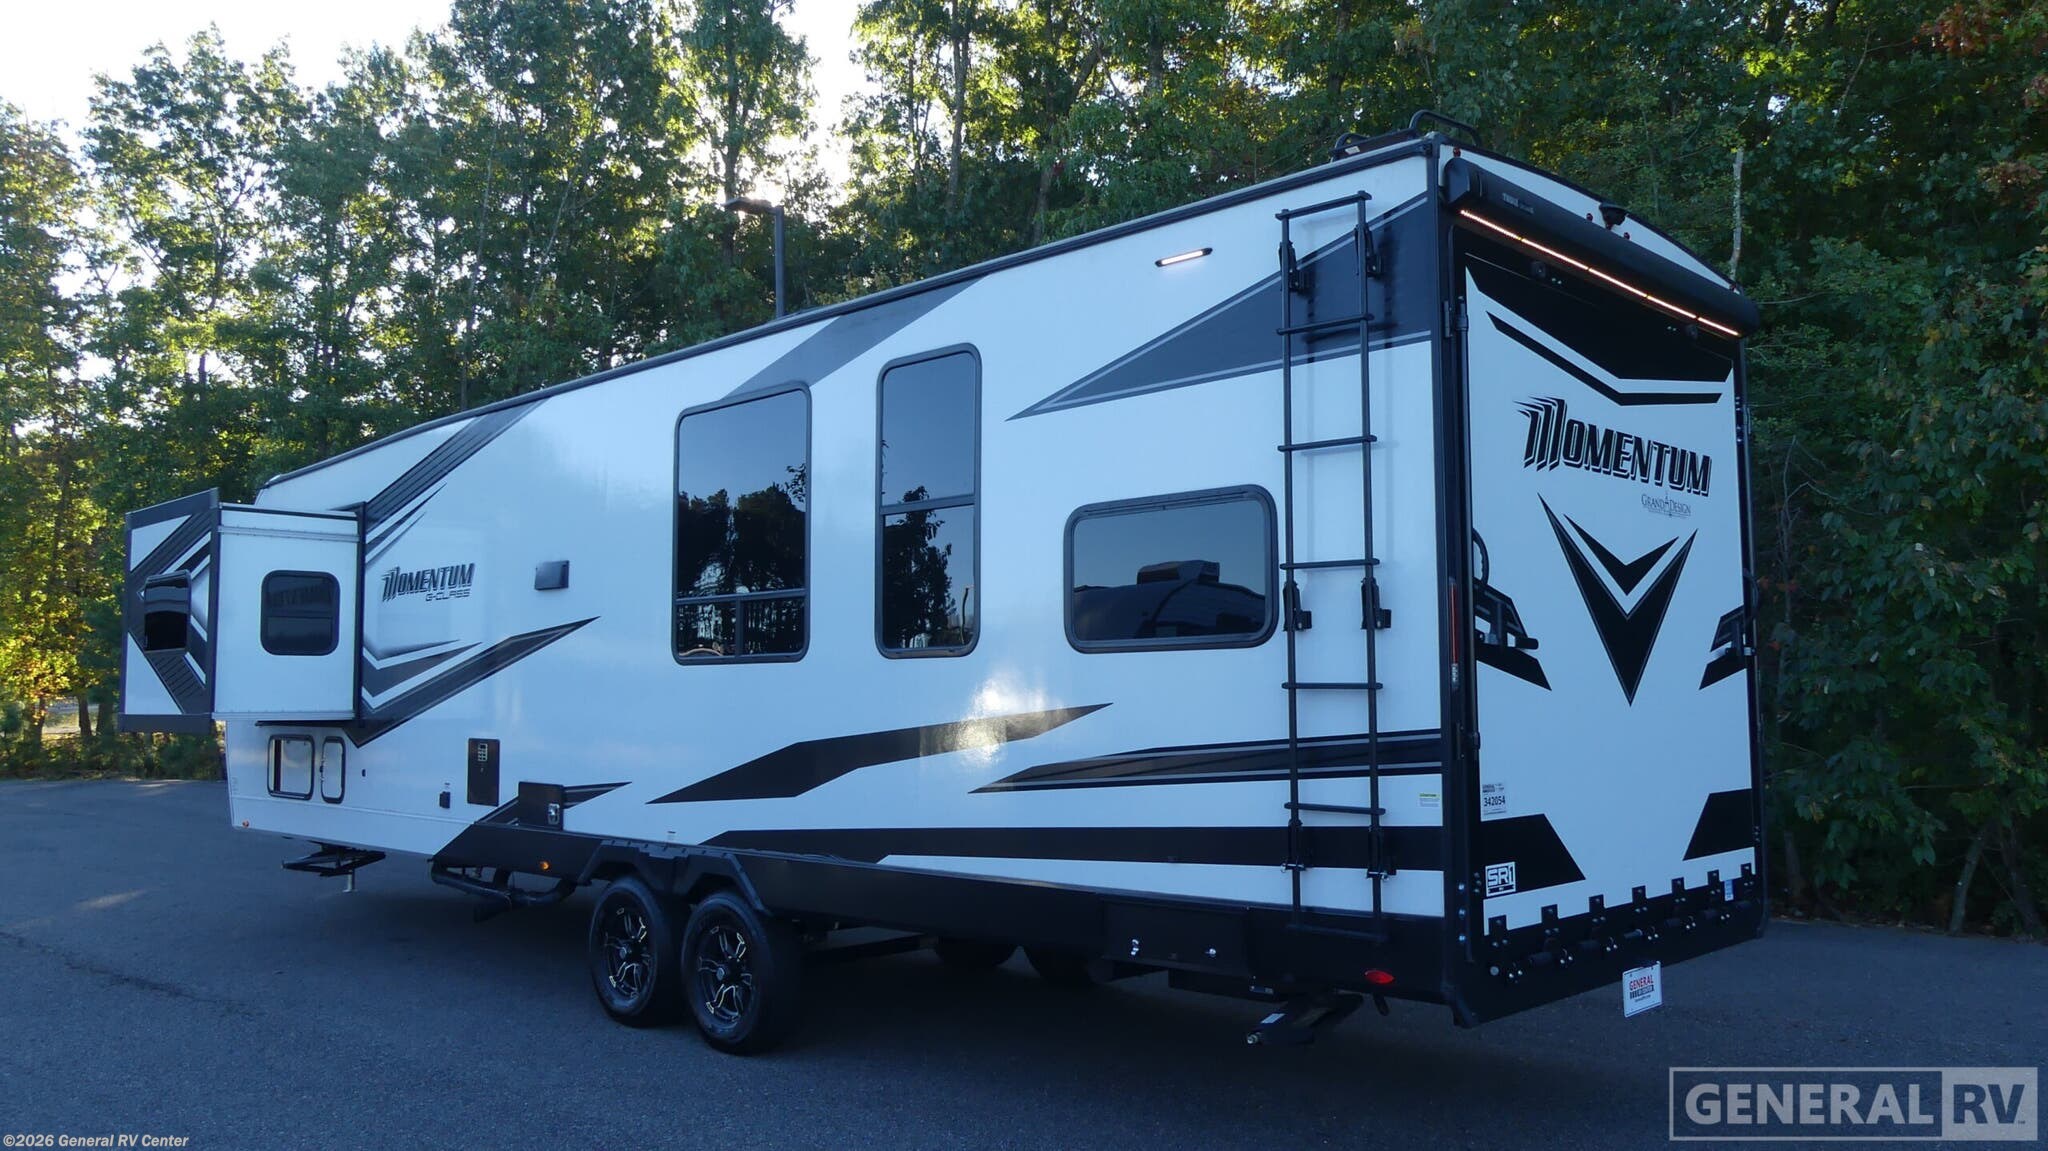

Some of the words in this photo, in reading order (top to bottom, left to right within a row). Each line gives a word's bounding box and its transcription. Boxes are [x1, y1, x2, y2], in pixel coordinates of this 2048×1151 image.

[1513, 395, 1712, 497] MOMENTUM
[381, 563, 475, 602] MOMENTUM
[425, 588, 471, 602] G-CLASS
[1629, 974, 1654, 991] GENERAL
